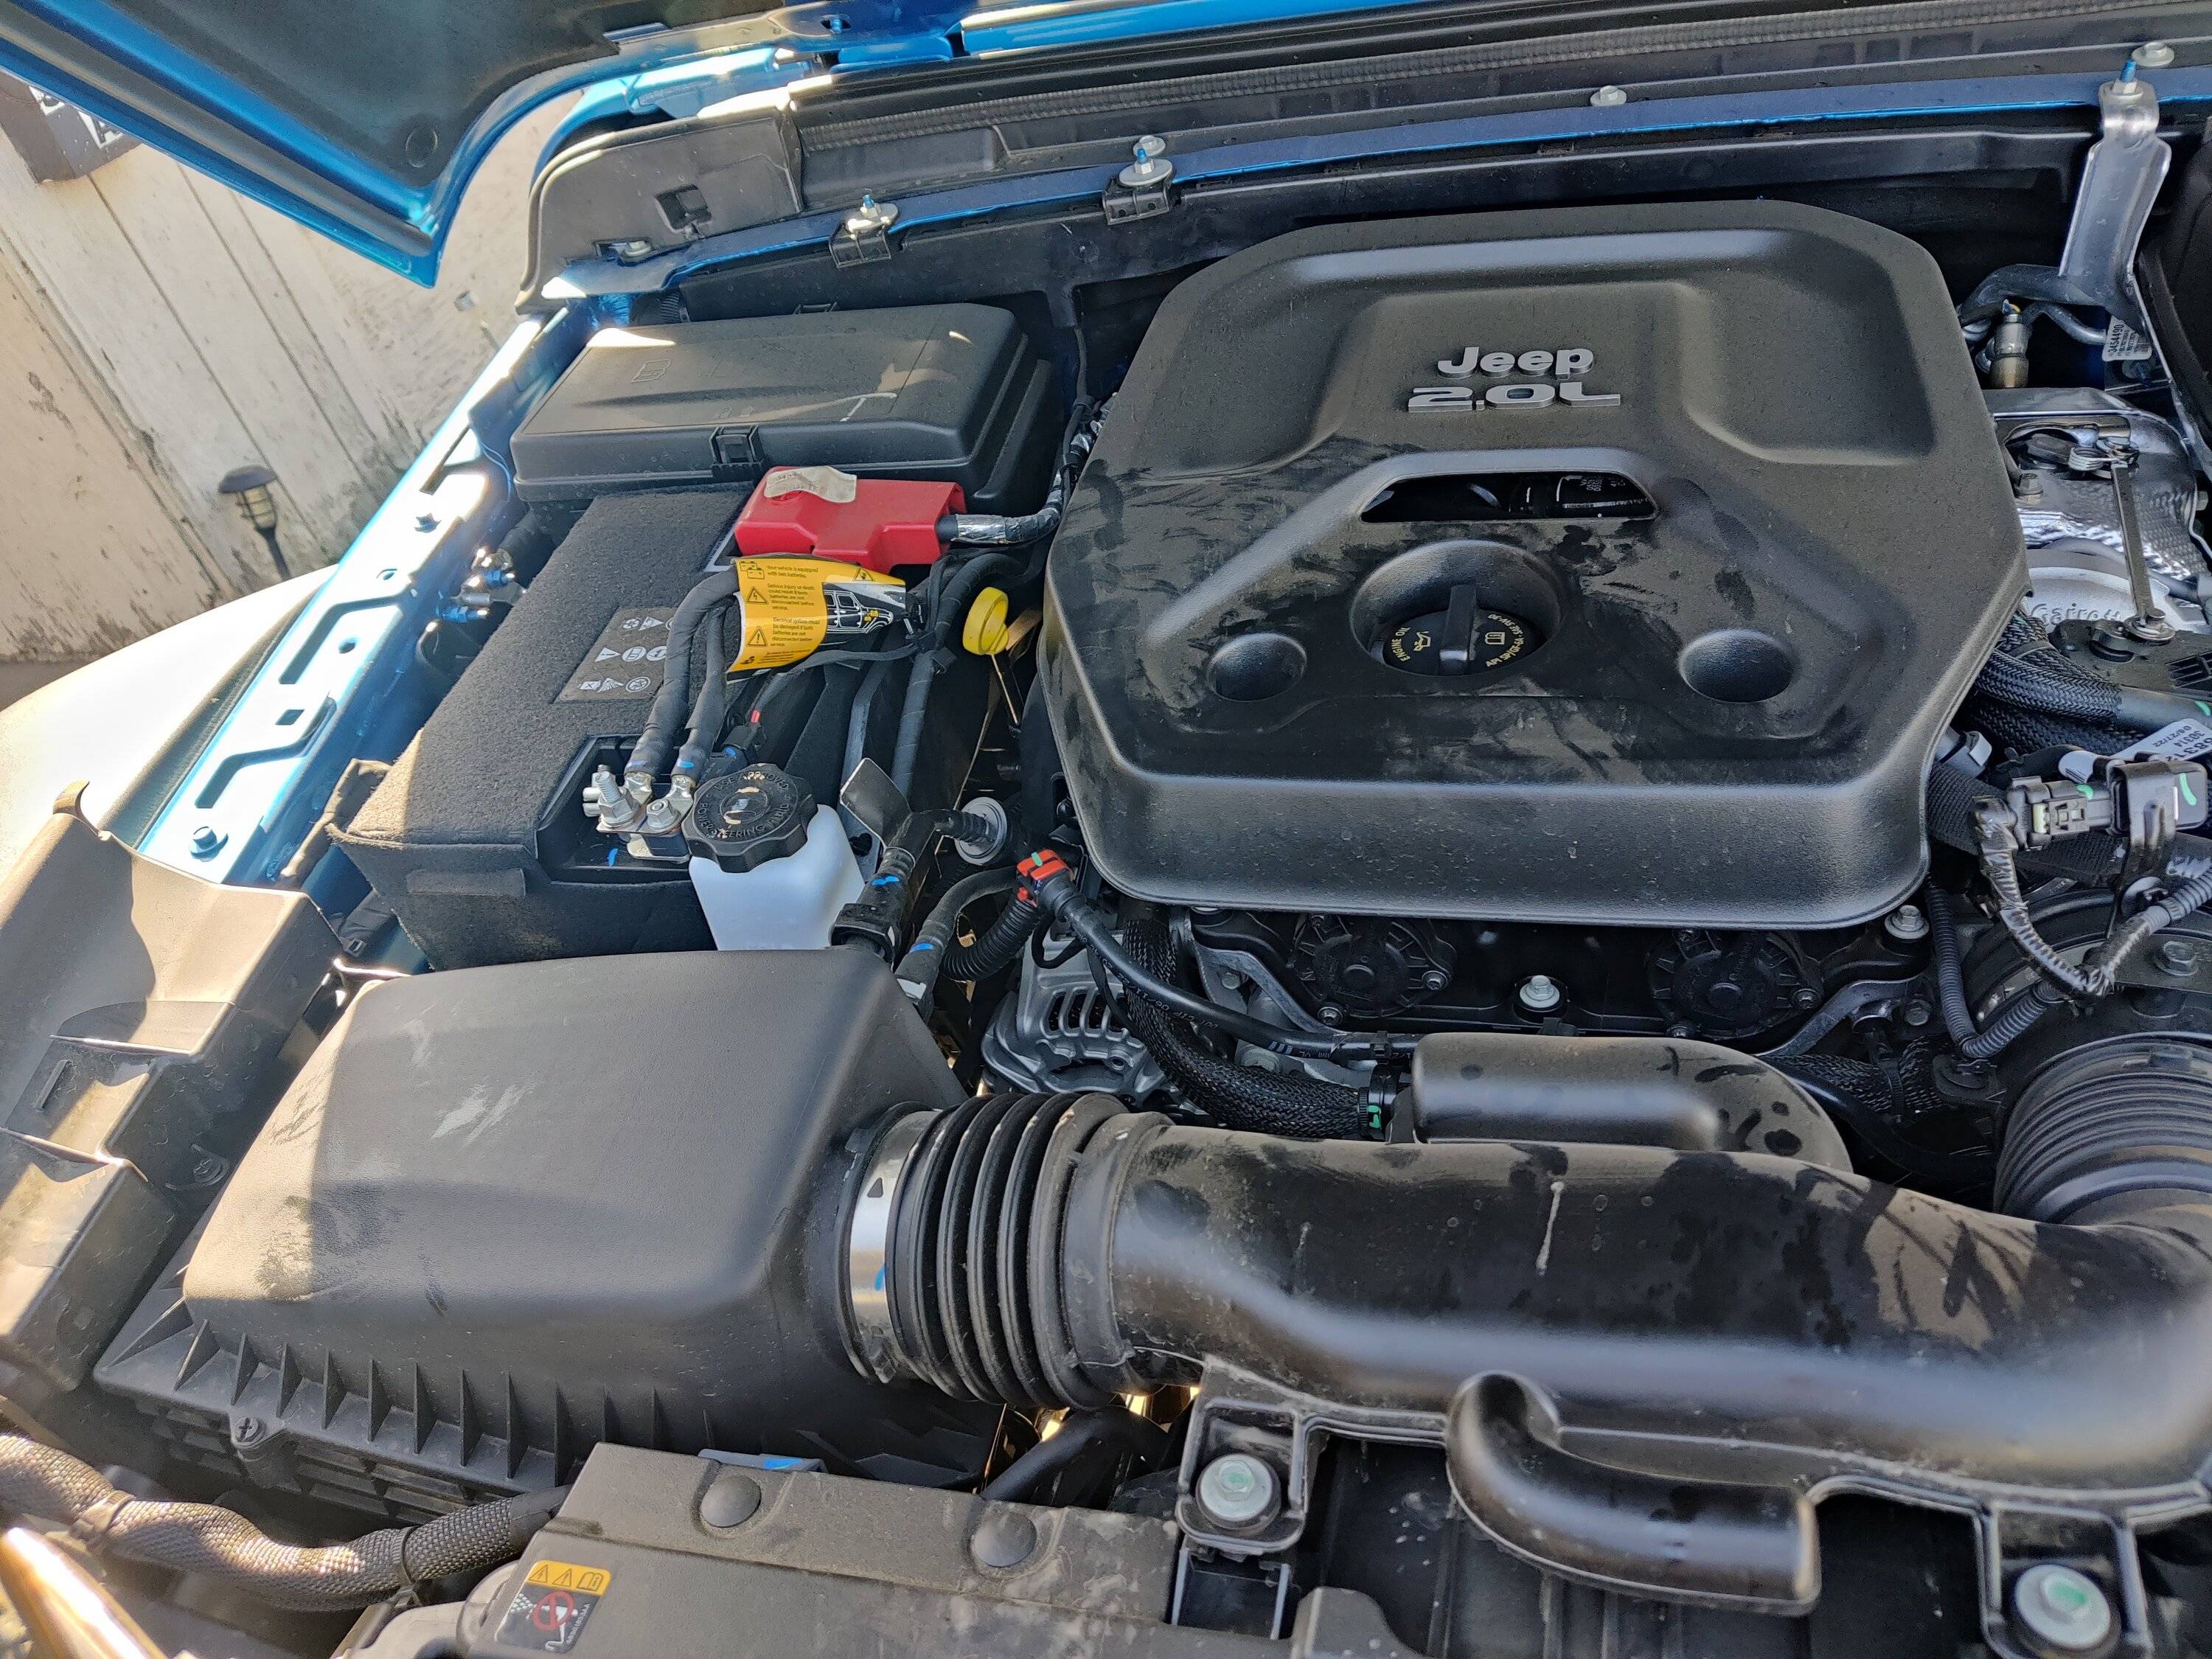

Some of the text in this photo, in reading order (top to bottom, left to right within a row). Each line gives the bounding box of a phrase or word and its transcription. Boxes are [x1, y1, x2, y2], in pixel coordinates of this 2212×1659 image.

[1438, 347, 1594, 380] Jeep
[1408, 382, 1621, 413] 2.0L
[1391, 627, 1411, 661] ENGINE OIL
[1486, 658, 1503, 667] API
[2152, 725, 2192, 748] 08/27/22
[714, 771, 790, 792] USE APPROVED
[697, 802, 790, 840] POWER STEERING FLUID
